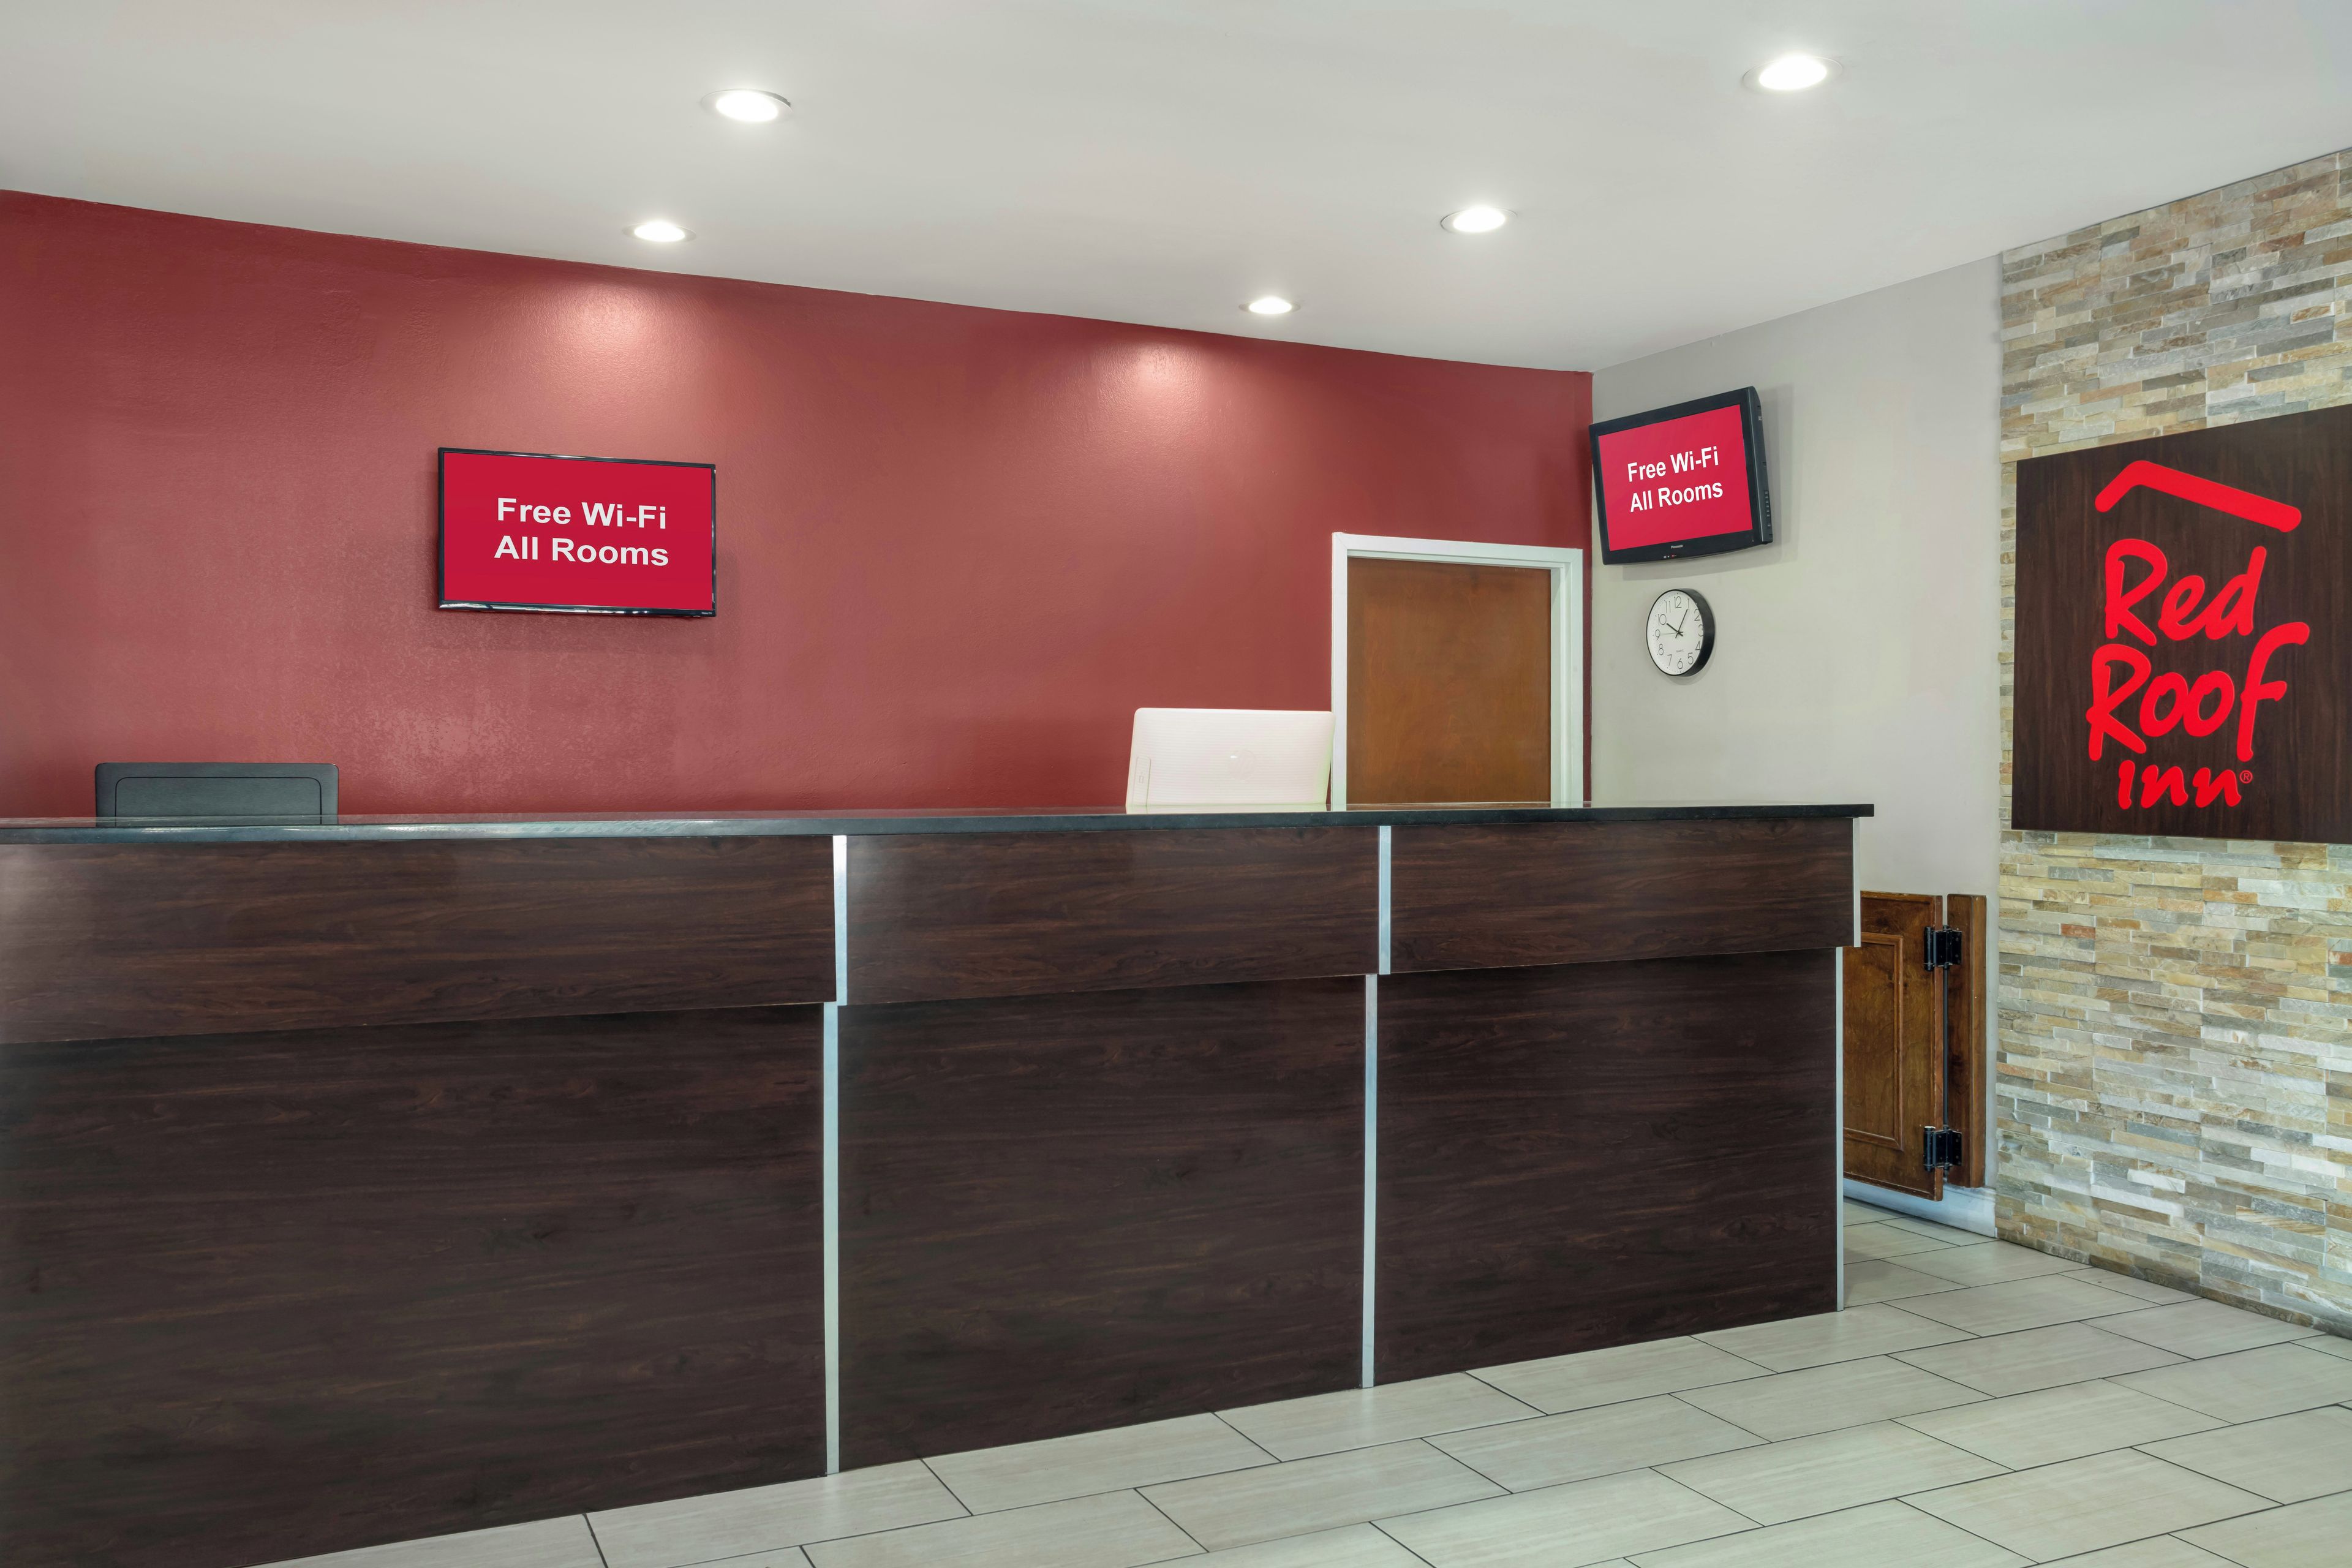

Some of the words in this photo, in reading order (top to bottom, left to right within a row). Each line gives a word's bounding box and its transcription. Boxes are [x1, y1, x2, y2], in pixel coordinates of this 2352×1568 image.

[1627, 461, 1667, 483] Free
[1670, 445, 1719, 473] Wi-Fi
[1630, 489, 1653, 513] All
[1657, 482, 1724, 508] Rooms
[498, 497, 571, 525] Free
[581, 502, 666, 529] Wi-Fi
[494, 535, 538, 560] All
[552, 538, 669, 567] Rooms
[2104, 538, 2267, 647] Red
[1665, 600, 1672, 613] 11
[1674, 596, 1682, 609] 12
[1657, 614, 1667, 626] 10
[1654, 629, 1660, 641] 9
[1658, 643, 1664, 656] 8
[1667, 654, 1673, 667] 7
[1677, 658, 1684, 669] 6
[1687, 652, 1694, 665] 5
[2085, 622, 2310, 763] Roof
